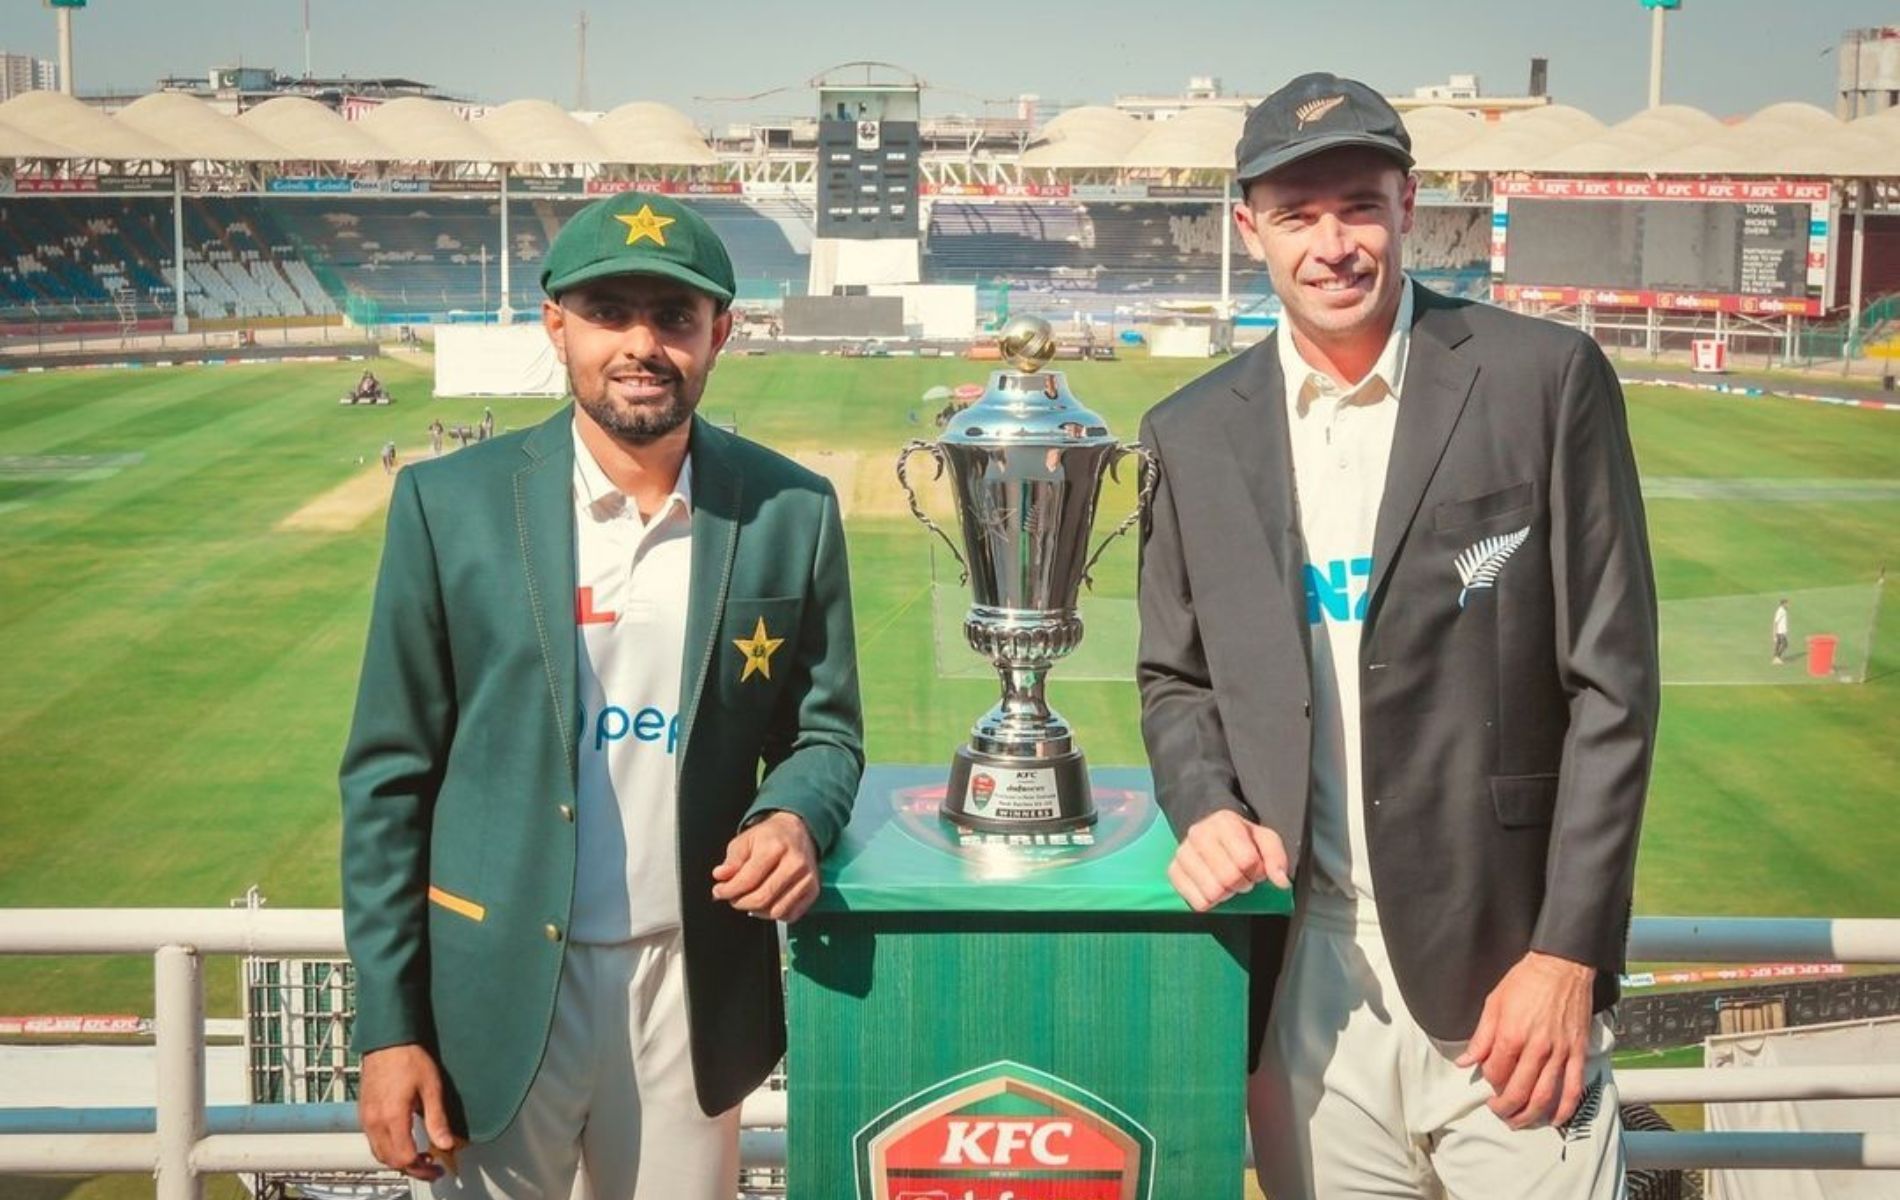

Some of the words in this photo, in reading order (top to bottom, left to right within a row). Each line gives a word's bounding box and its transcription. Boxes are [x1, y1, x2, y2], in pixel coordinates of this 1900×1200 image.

[600, 183, 625, 192] KFC
[636, 183, 661, 192] KFC
[1041, 185, 1065, 196] KFC
[1508, 182, 1533, 193] KFC
[1545, 183, 1570, 194] KFC
[1584, 183, 1609, 194] KFC
[1624, 183, 1650, 194] KFC
[1665, 184, 1693, 196] KFC
[1707, 184, 1735, 196] KFC
[1750, 185, 1779, 197] KFC
[1794, 186, 1824, 198] KFC
[1745, 203, 1777, 215] TOTAL
[576, 586, 616, 625] L
[1016, 771, 1037, 779] KFC
[998, 809, 1052, 818] WINNERS
[939, 1121, 1074, 1166] KFC
